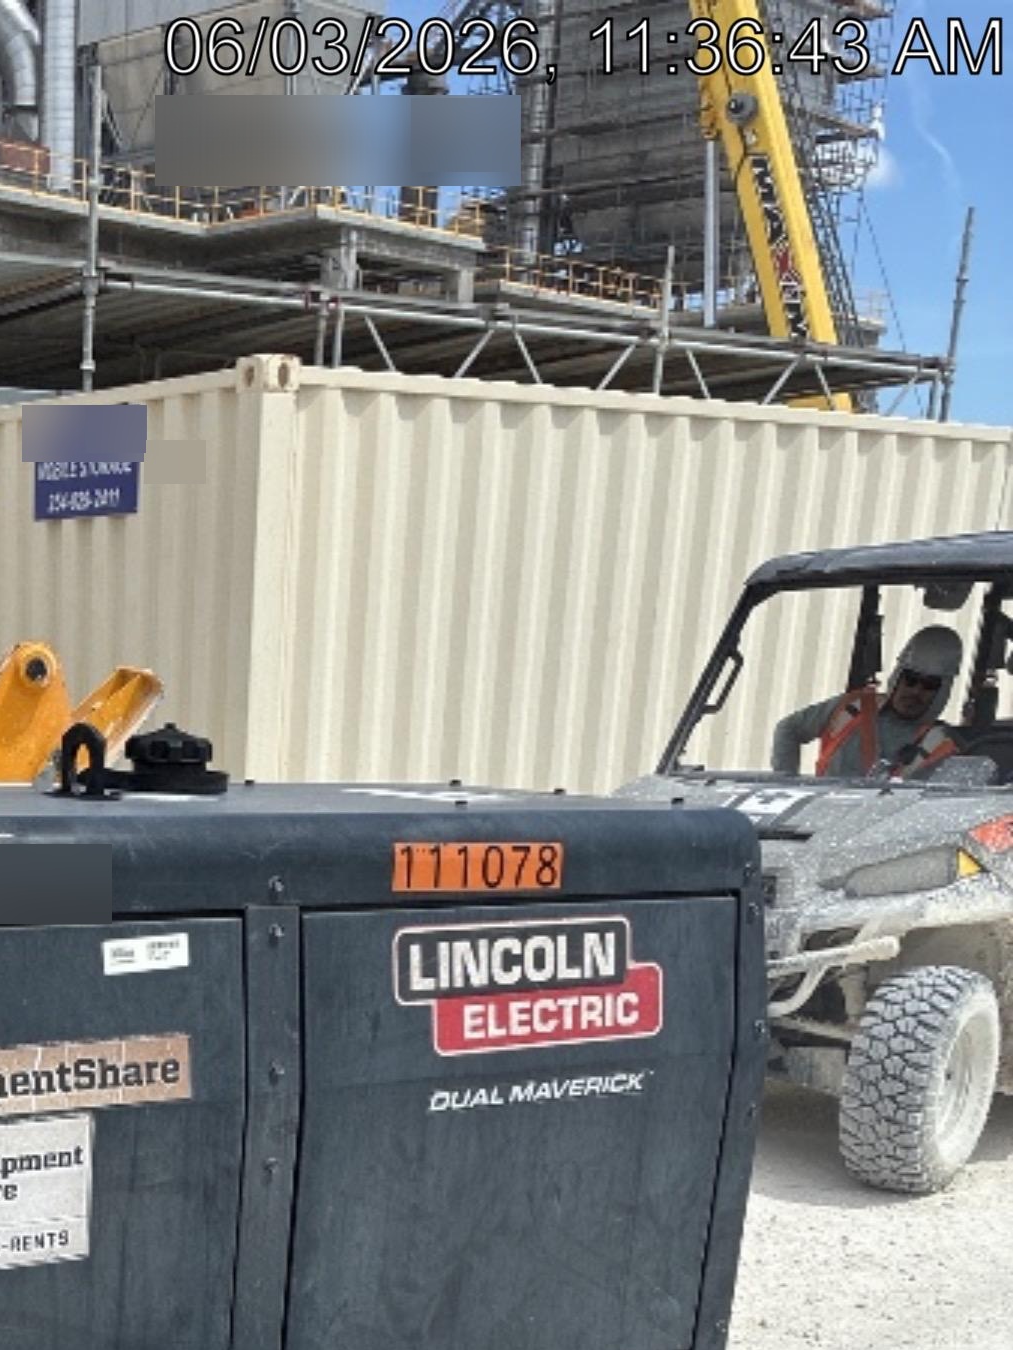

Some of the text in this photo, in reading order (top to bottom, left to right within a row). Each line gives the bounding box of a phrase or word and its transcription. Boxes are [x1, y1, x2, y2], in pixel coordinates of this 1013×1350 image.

[399, 845, 559, 889] 111078
[408, 931, 617, 991] LINCOLN
[462, 991, 640, 1041] ELECTRIC
[428, 1070, 646, 1112] DUAL MAVERICK
